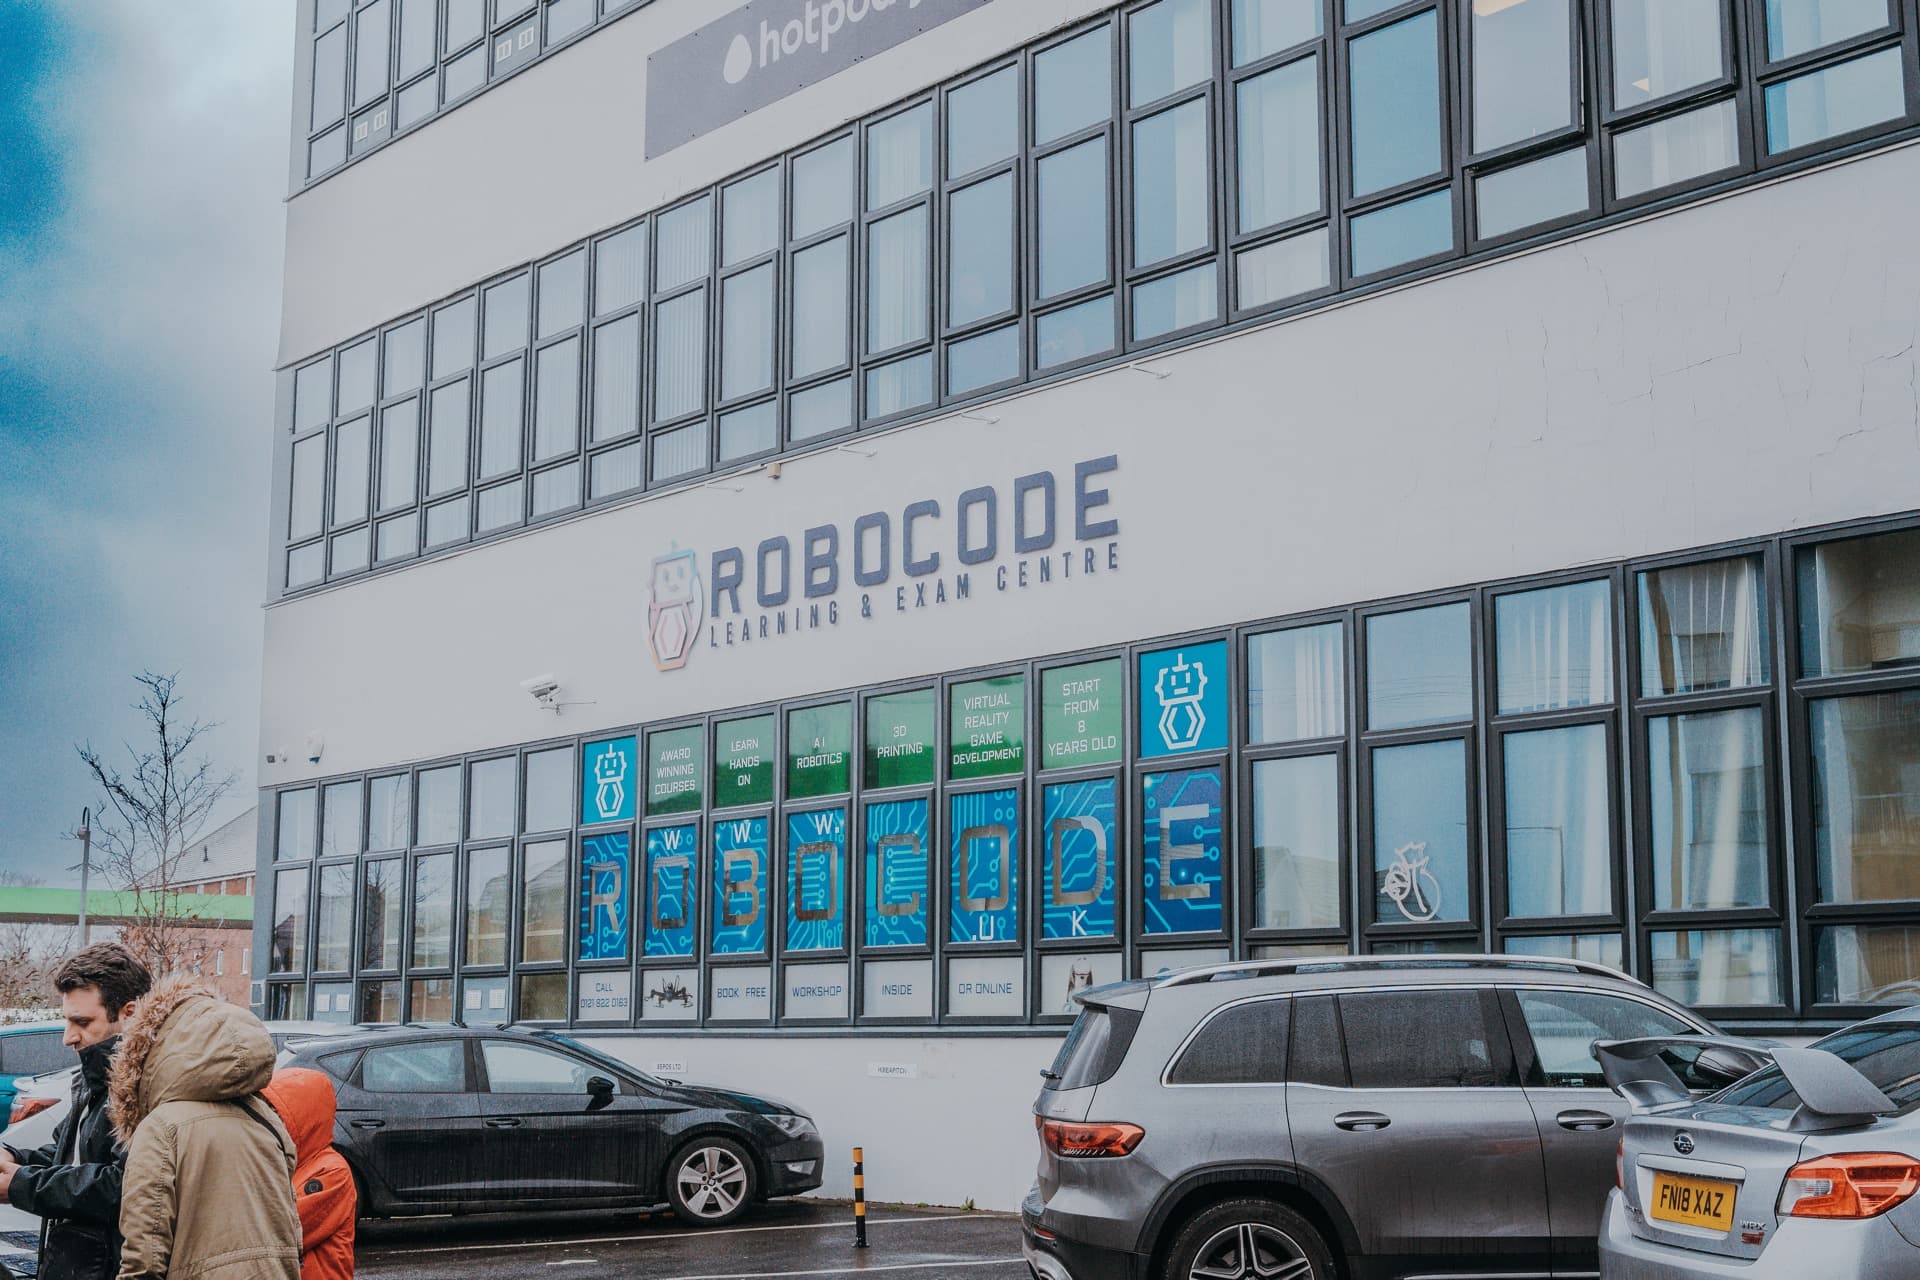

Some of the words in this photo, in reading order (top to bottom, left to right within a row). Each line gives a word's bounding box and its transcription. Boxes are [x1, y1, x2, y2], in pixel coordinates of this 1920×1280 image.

[760, 0, 898, 68] hotpo
[710, 454, 1119, 618] ROBOCODE
[711, 600, 838, 648] LEARNING
[861, 594, 872, 618] &
[897, 573, 970, 611] EXAM
[997, 541, 1119, 592] CENTRE
[1062, 679, 1101, 697] START
[963, 693, 1011, 711] VIRTUAL
[1064, 698, 1099, 717] FROM
[964, 711, 1010, 729] REALITY
[1077, 720, 1086, 733] 8
[893, 725, 907, 738] 3D
[970, 731, 1003, 747] GAME
[731, 738, 759, 752] LEARN
[877, 742, 923, 758] PRINTING
[1048, 738, 1088, 757] YEARS
[1092, 735, 1117, 750] OLD
[660, 747, 691, 761] AWARD
[796, 752, 842, 769] ROBOTICS
[953, 747, 1021, 765] DEVELOPMENT
[656, 763, 694, 778] WINNING
[729, 756, 759, 770] HANDS
[655, 779, 696, 795] COURSES
[737, 774, 751, 786] ON
[595, 982, 614, 992] CALL
[717, 987, 739, 998] BOOK
[745, 987, 767, 998] FREE
[792, 986, 842, 998] WORKSHOP
[881, 984, 913, 995] INSIDE
[958, 983, 973, 994] OR
[975, 982, 1013, 994] ONLINE
[1660, 1184, 1691, 1212] FN18
[1693, 1188, 1724, 1218] XAZ
